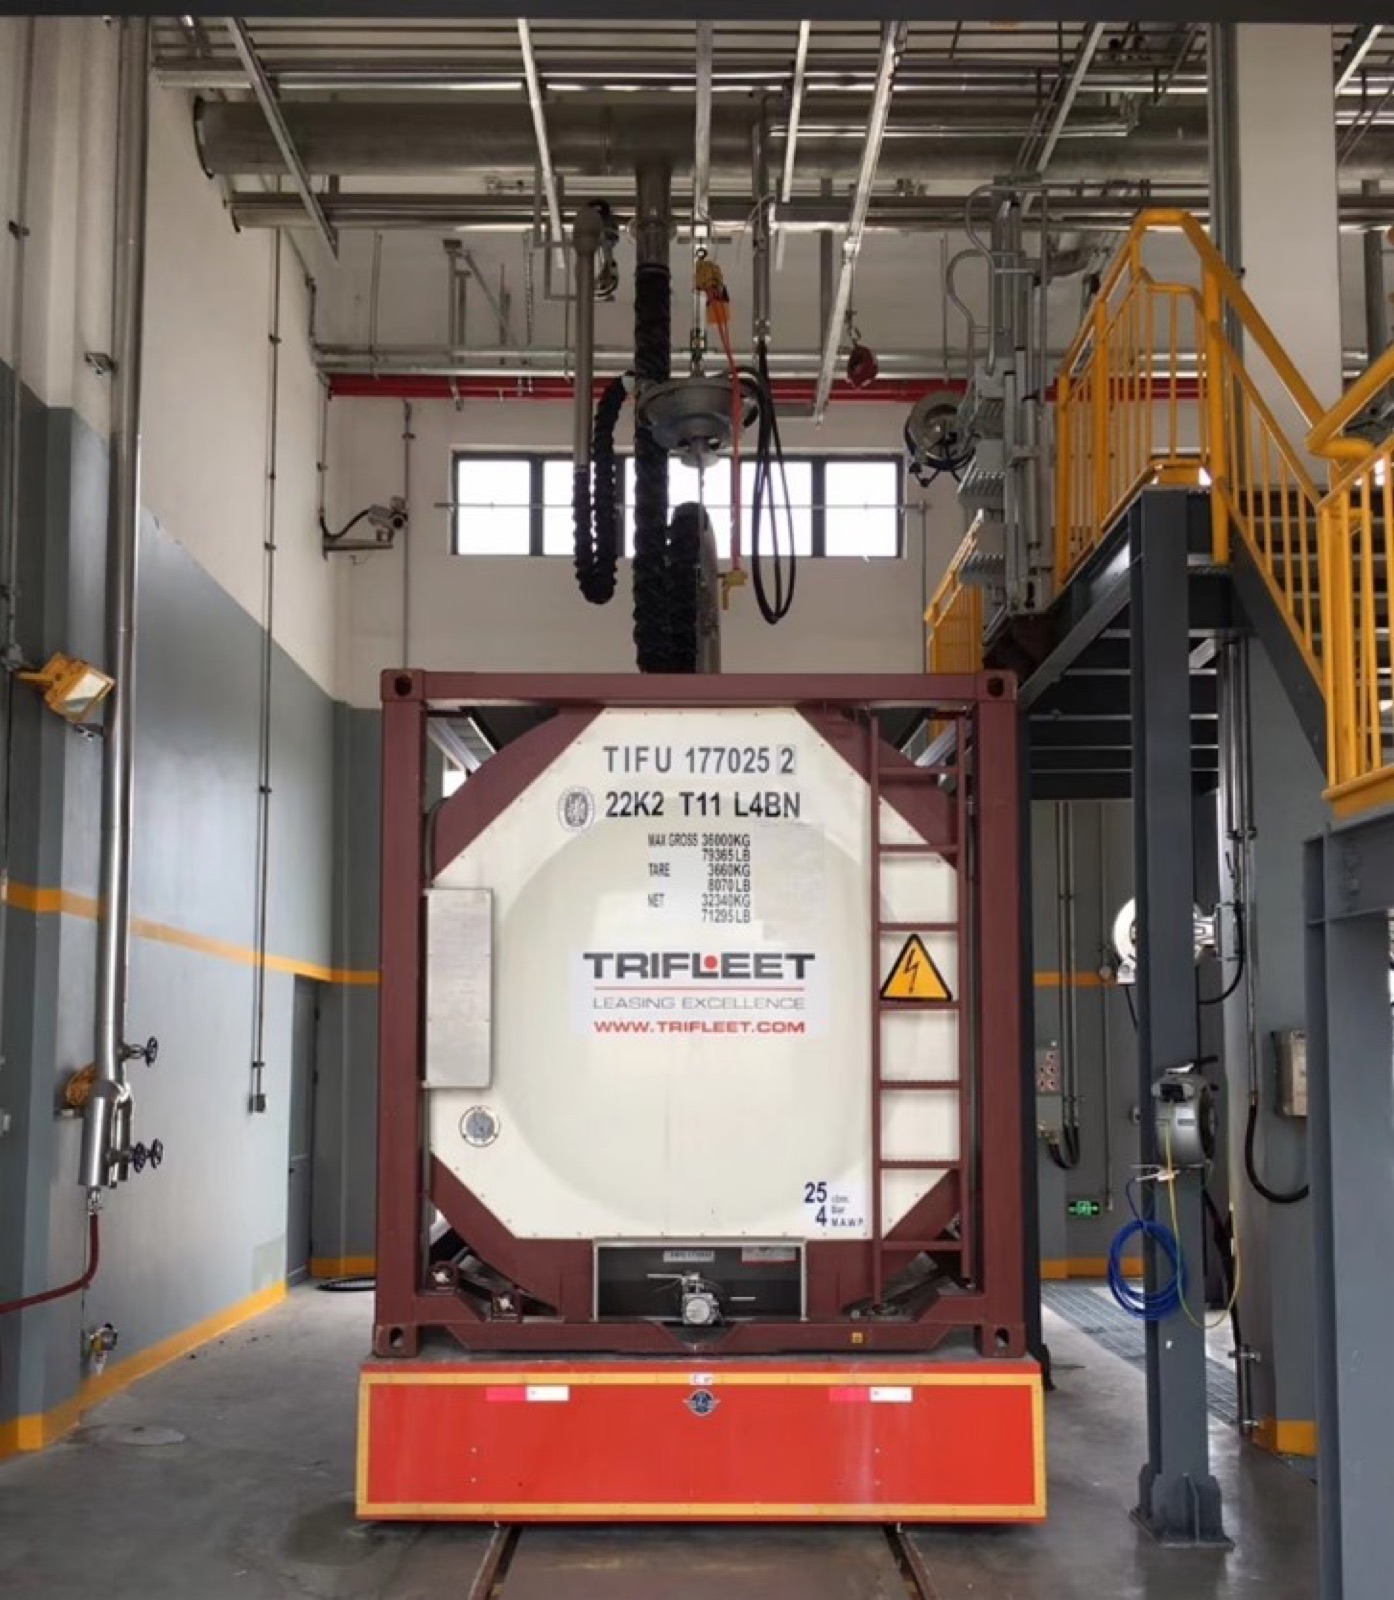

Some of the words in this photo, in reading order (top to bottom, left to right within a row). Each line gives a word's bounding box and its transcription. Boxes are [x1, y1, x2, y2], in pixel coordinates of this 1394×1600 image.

[603, 746, 672, 773] TIFU
[685, 747, 770, 774] 177025
[779, 748, 795, 774] 2
[605, 791, 664, 818] 22K2
[679, 791, 721, 817] T11
[734, 792, 801, 818] L4BN
[668, 832, 698, 847] GROSS
[648, 862, 671, 877] TARE
[648, 892, 665, 908] NET
[583, 952, 816, 980] TRIFLEET
[593, 997, 675, 1010] LEASING
[682, 997, 805, 1010] EXCELLENCE
[593, 1021, 806, 1033] WWW.TRIFLEET.COM
[804, 1181, 828, 1204] 25
[815, 1204, 828, 1227] 4
